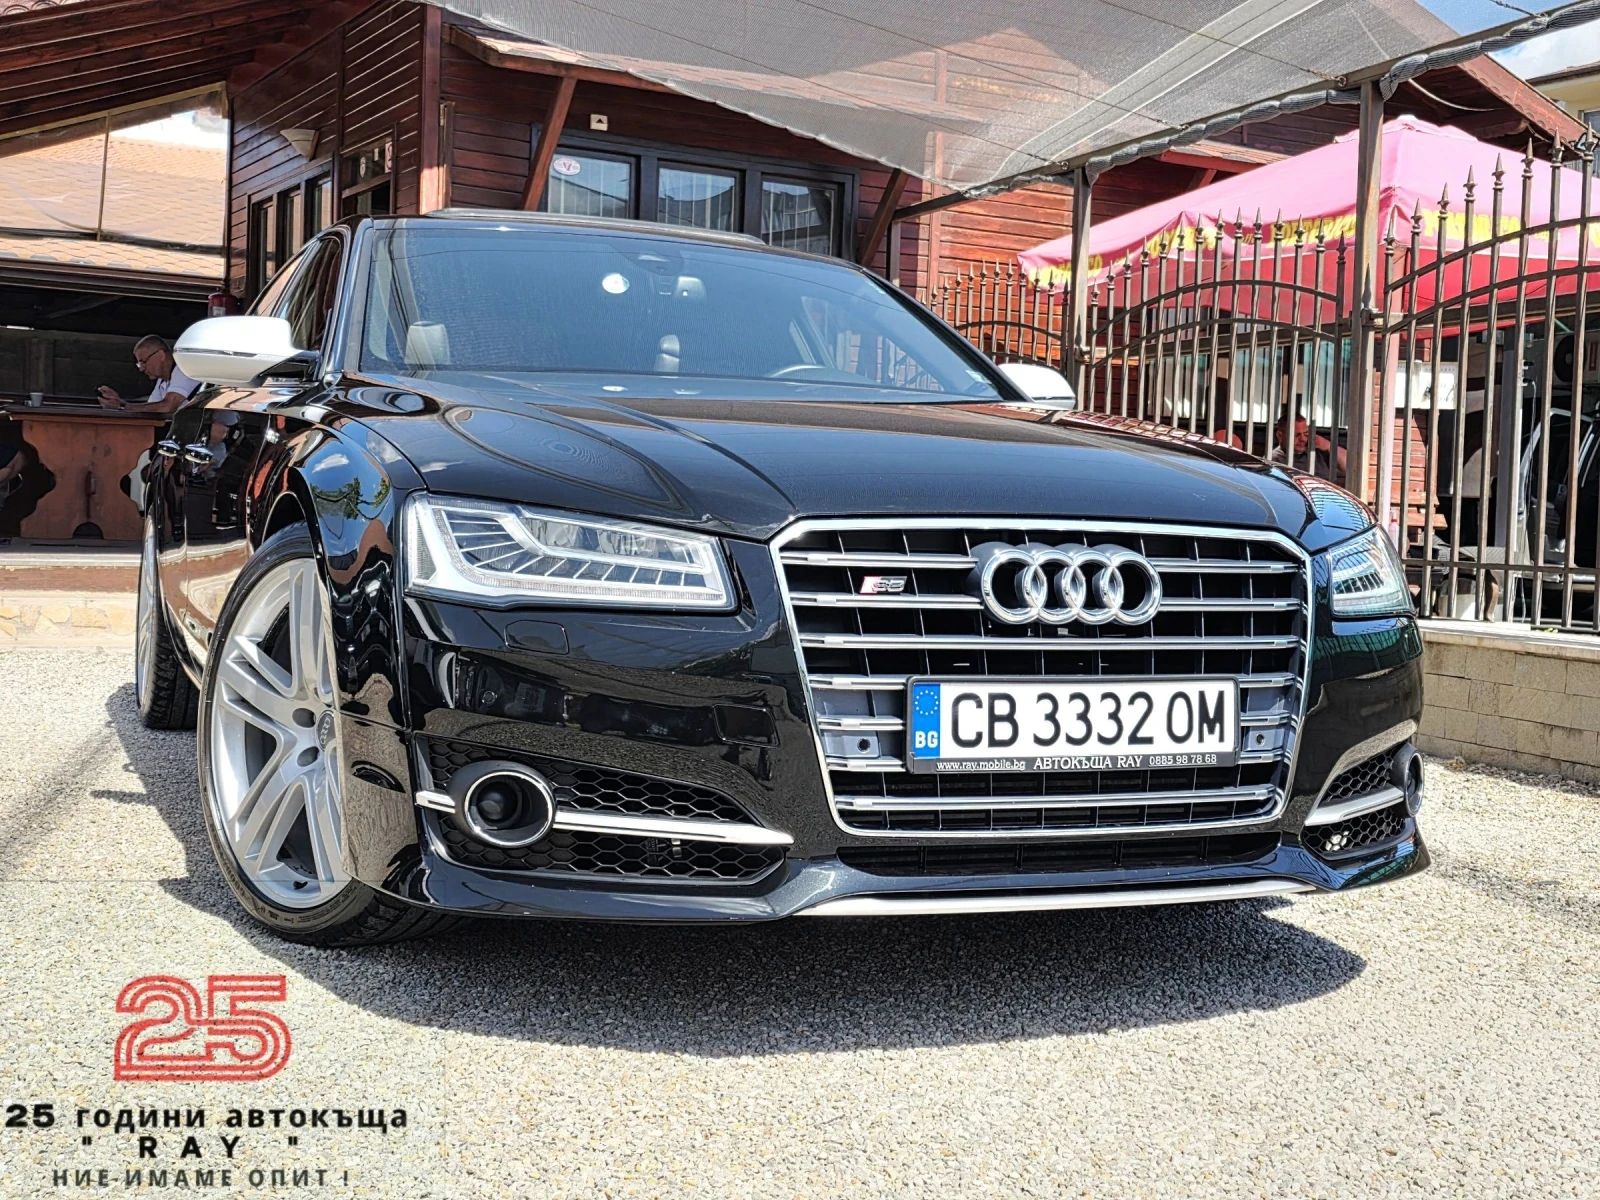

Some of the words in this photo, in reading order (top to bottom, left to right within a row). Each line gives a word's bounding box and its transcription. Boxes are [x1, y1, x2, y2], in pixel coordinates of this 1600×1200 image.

[1033, 691, 1154, 747] 3332
[915, 731, 938, 749] BG
[936, 759, 1026, 771] www.ray.mobile.bg
[1033, 756, 1112, 770] АВТОКЪЩА
[1117, 756, 1143, 768] RAY
[1149, 756, 1174, 766] 0885
[1176, 755, 1188, 765] 98
[1191, 755, 1203, 764] 78
[1205, 754, 1217, 764] 68
